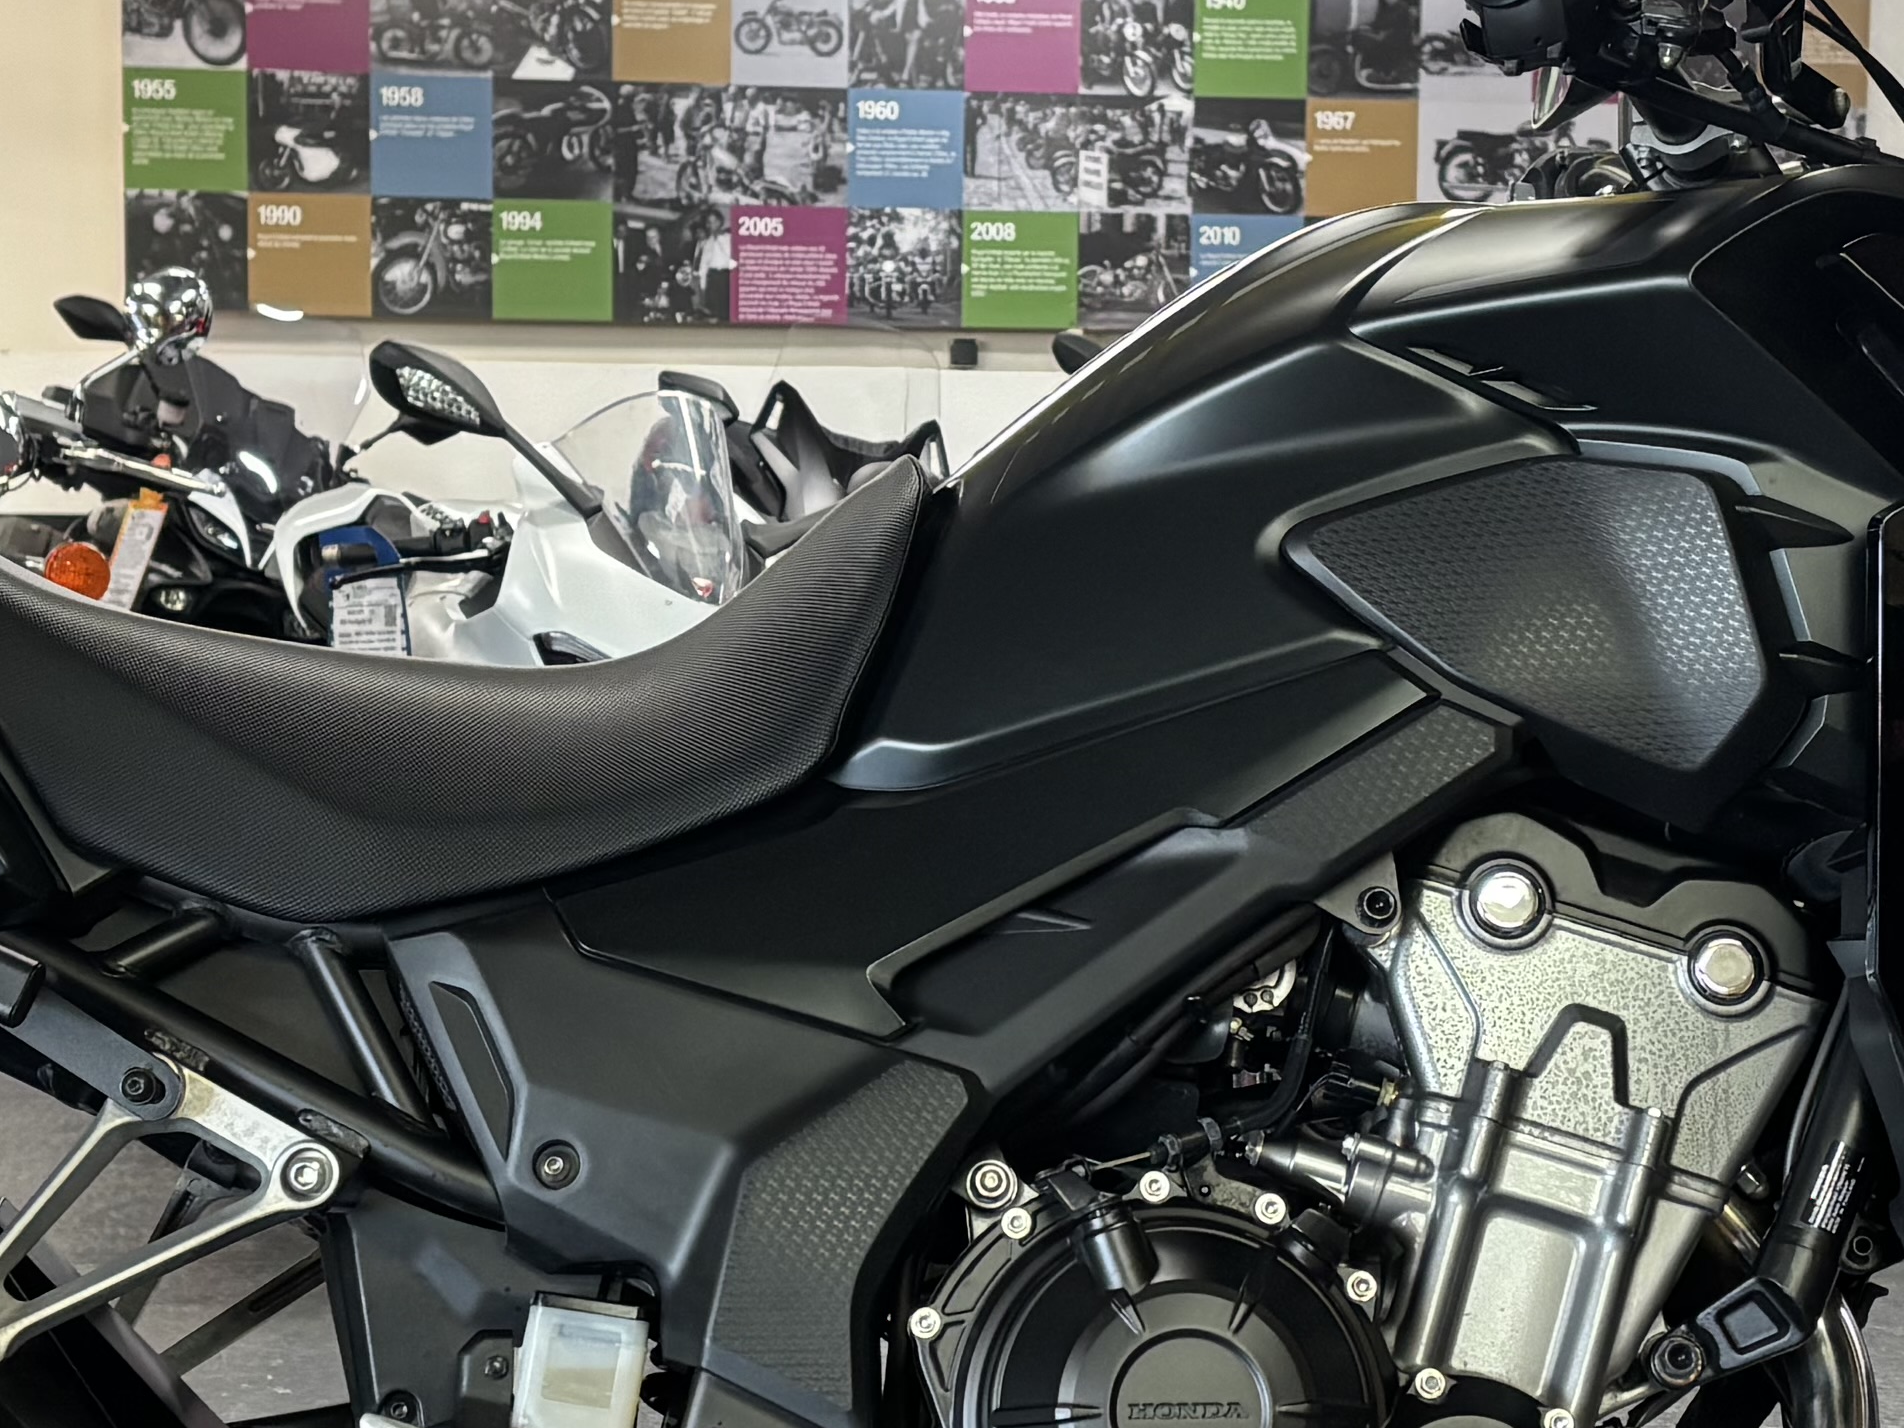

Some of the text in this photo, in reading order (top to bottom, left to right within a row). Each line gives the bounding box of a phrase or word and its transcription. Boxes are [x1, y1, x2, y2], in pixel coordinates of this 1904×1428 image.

[133, 79, 176, 99] 1955
[381, 86, 423, 106] 1958
[857, 100, 899, 120] 1960
[1315, 111, 1355, 130] 1967
[259, 206, 301, 225] 1990
[501, 211, 542, 230] 1994
[738, 216, 784, 237] 2005
[971, 222, 1016, 241] 2008
[1199, 225, 1240, 245] 2010
[1128, 1401, 1250, 1421] HONDA
